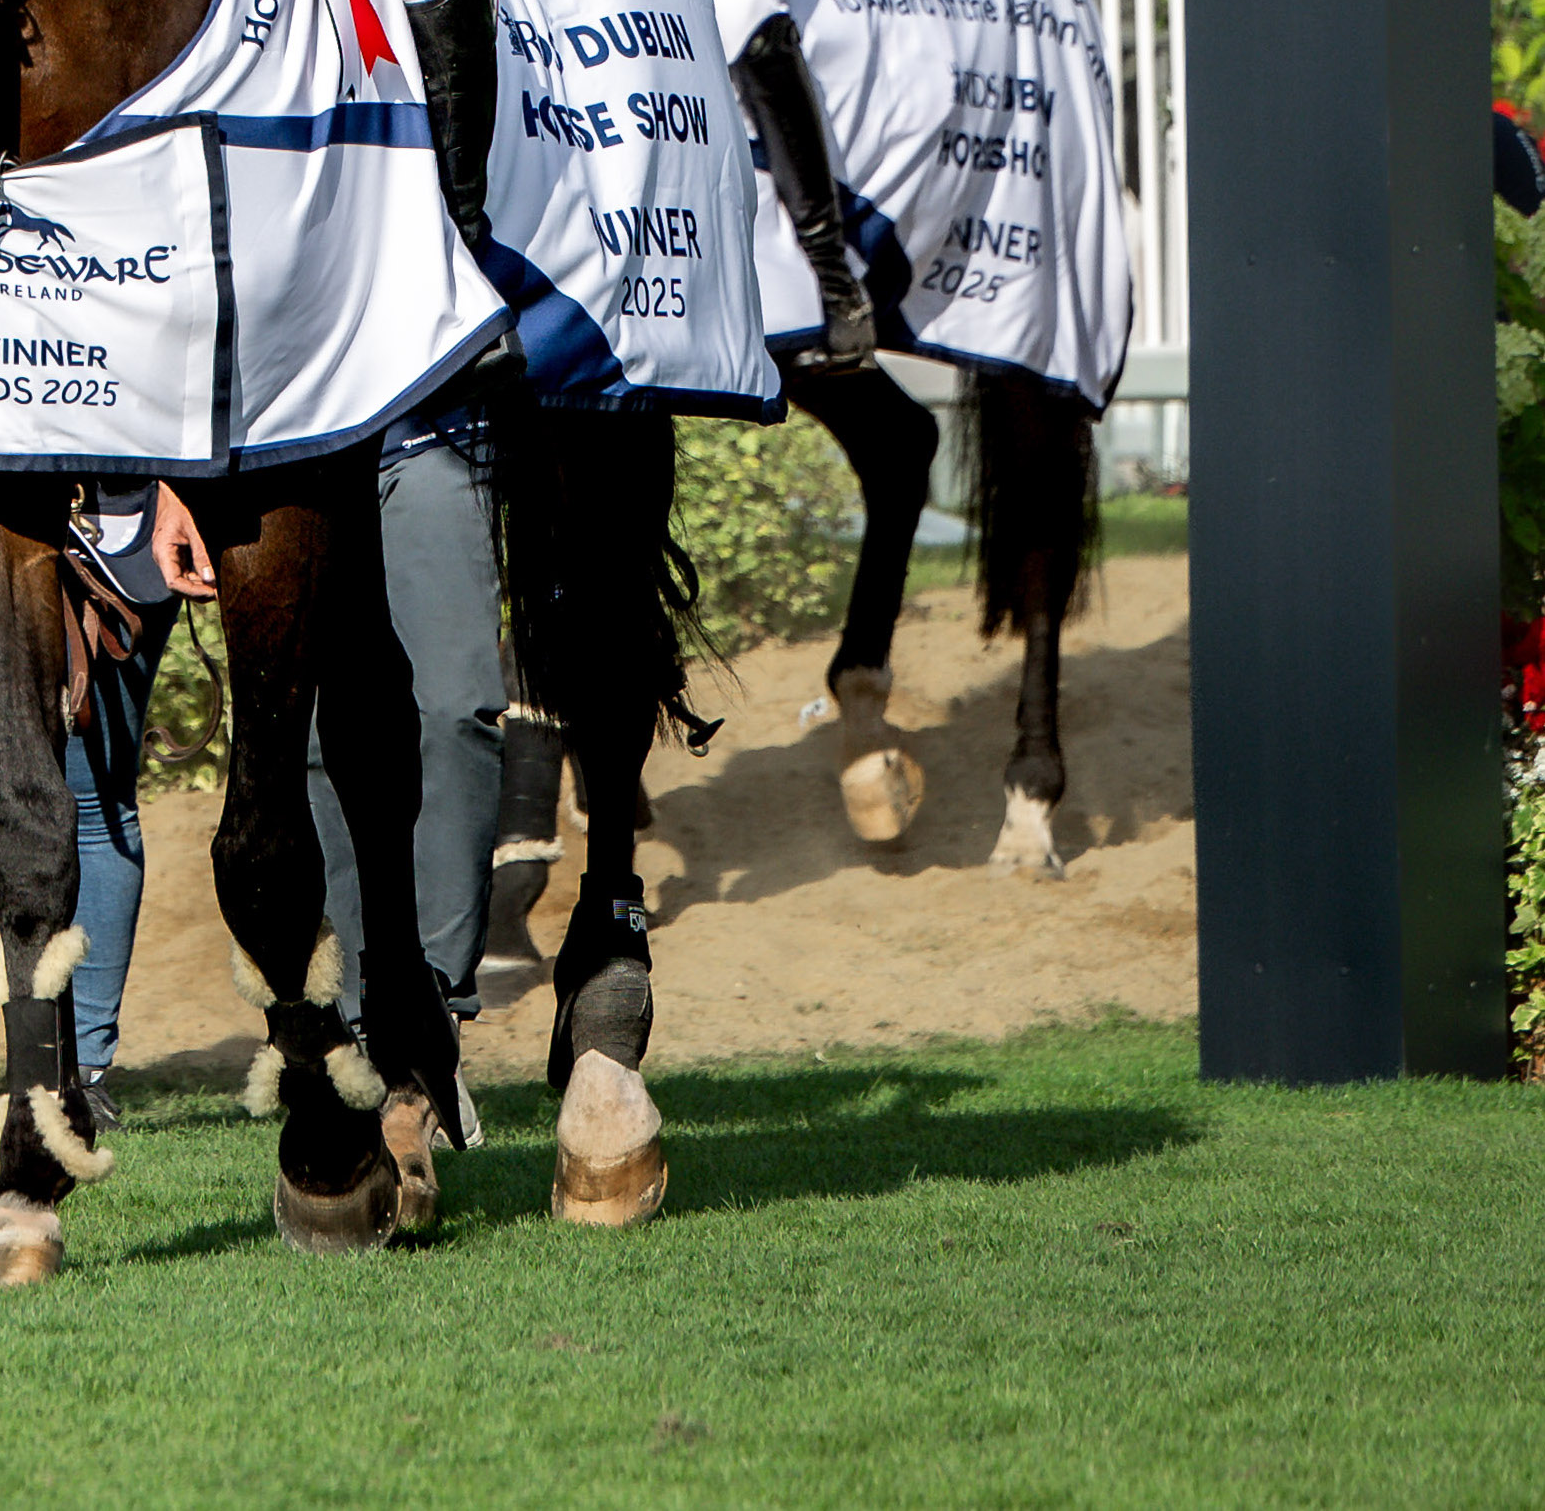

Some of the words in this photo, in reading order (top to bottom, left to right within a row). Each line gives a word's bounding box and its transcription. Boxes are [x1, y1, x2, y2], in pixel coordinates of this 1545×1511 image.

[564, 11, 696, 69] DUBLIN
[627, 91, 709, 146] SHOW
[620, 276, 686, 318] 2025
[922, 257, 1004, 303] 2025
[41, 378, 121, 407] 2025
